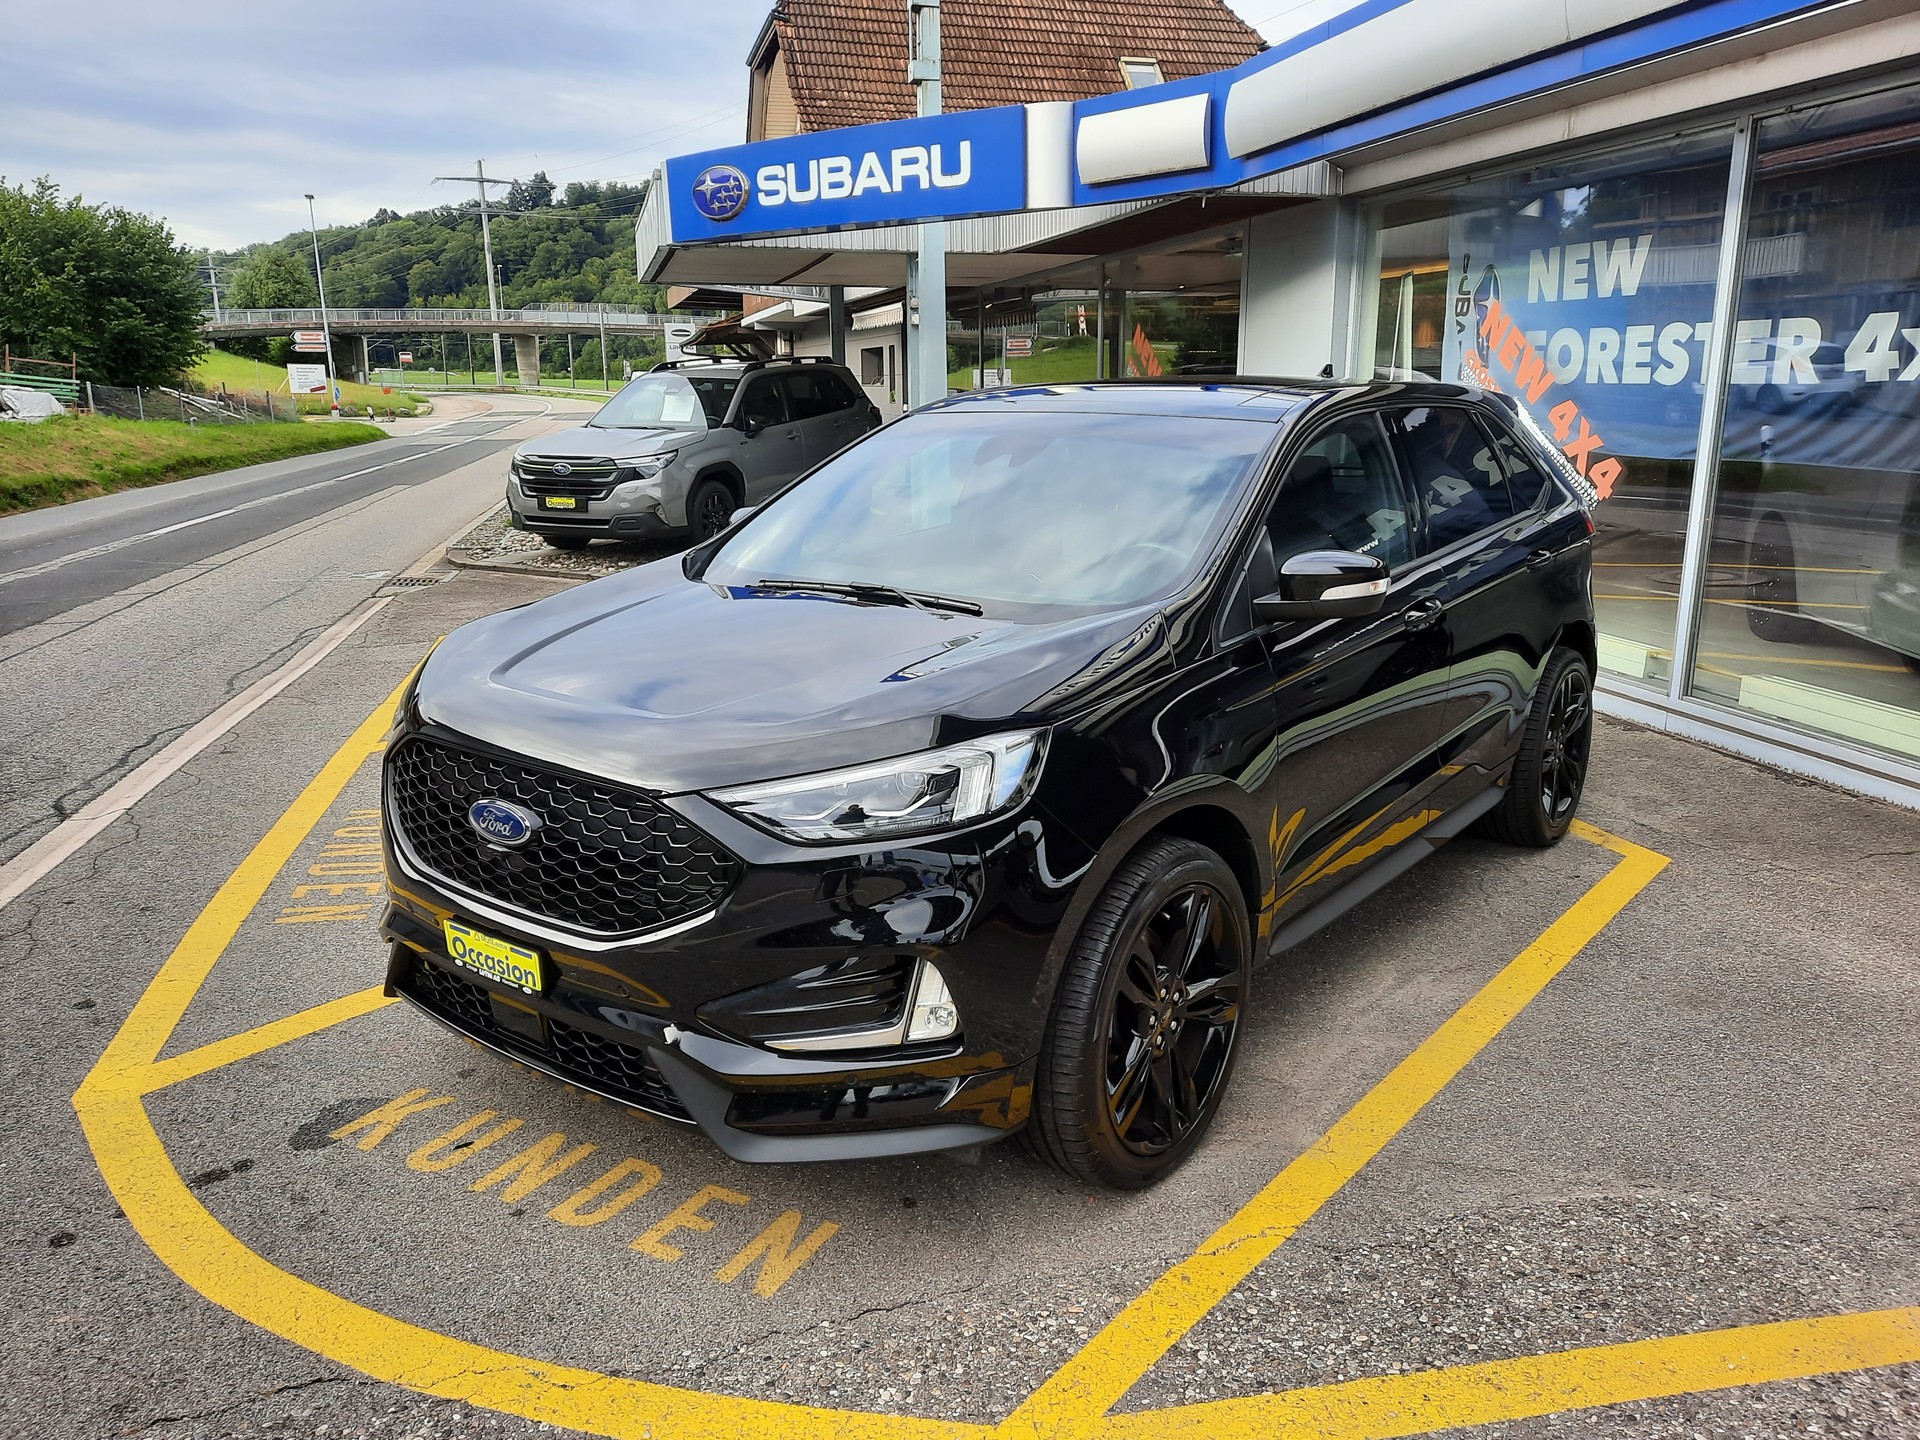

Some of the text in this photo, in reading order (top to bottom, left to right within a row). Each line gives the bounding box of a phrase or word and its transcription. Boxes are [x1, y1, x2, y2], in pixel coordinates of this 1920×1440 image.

[756, 140, 972, 206] SUBARU
[1528, 234, 1653, 303] NEW
[1479, 299, 1557, 404] NEW
[1548, 400, 1623, 501] 4X4
[480, 807, 514, 836] Ford
[274, 809, 384, 924] KUNDEN
[452, 936, 537, 988] Occasion
[328, 1088, 842, 1299] KUNDEN
